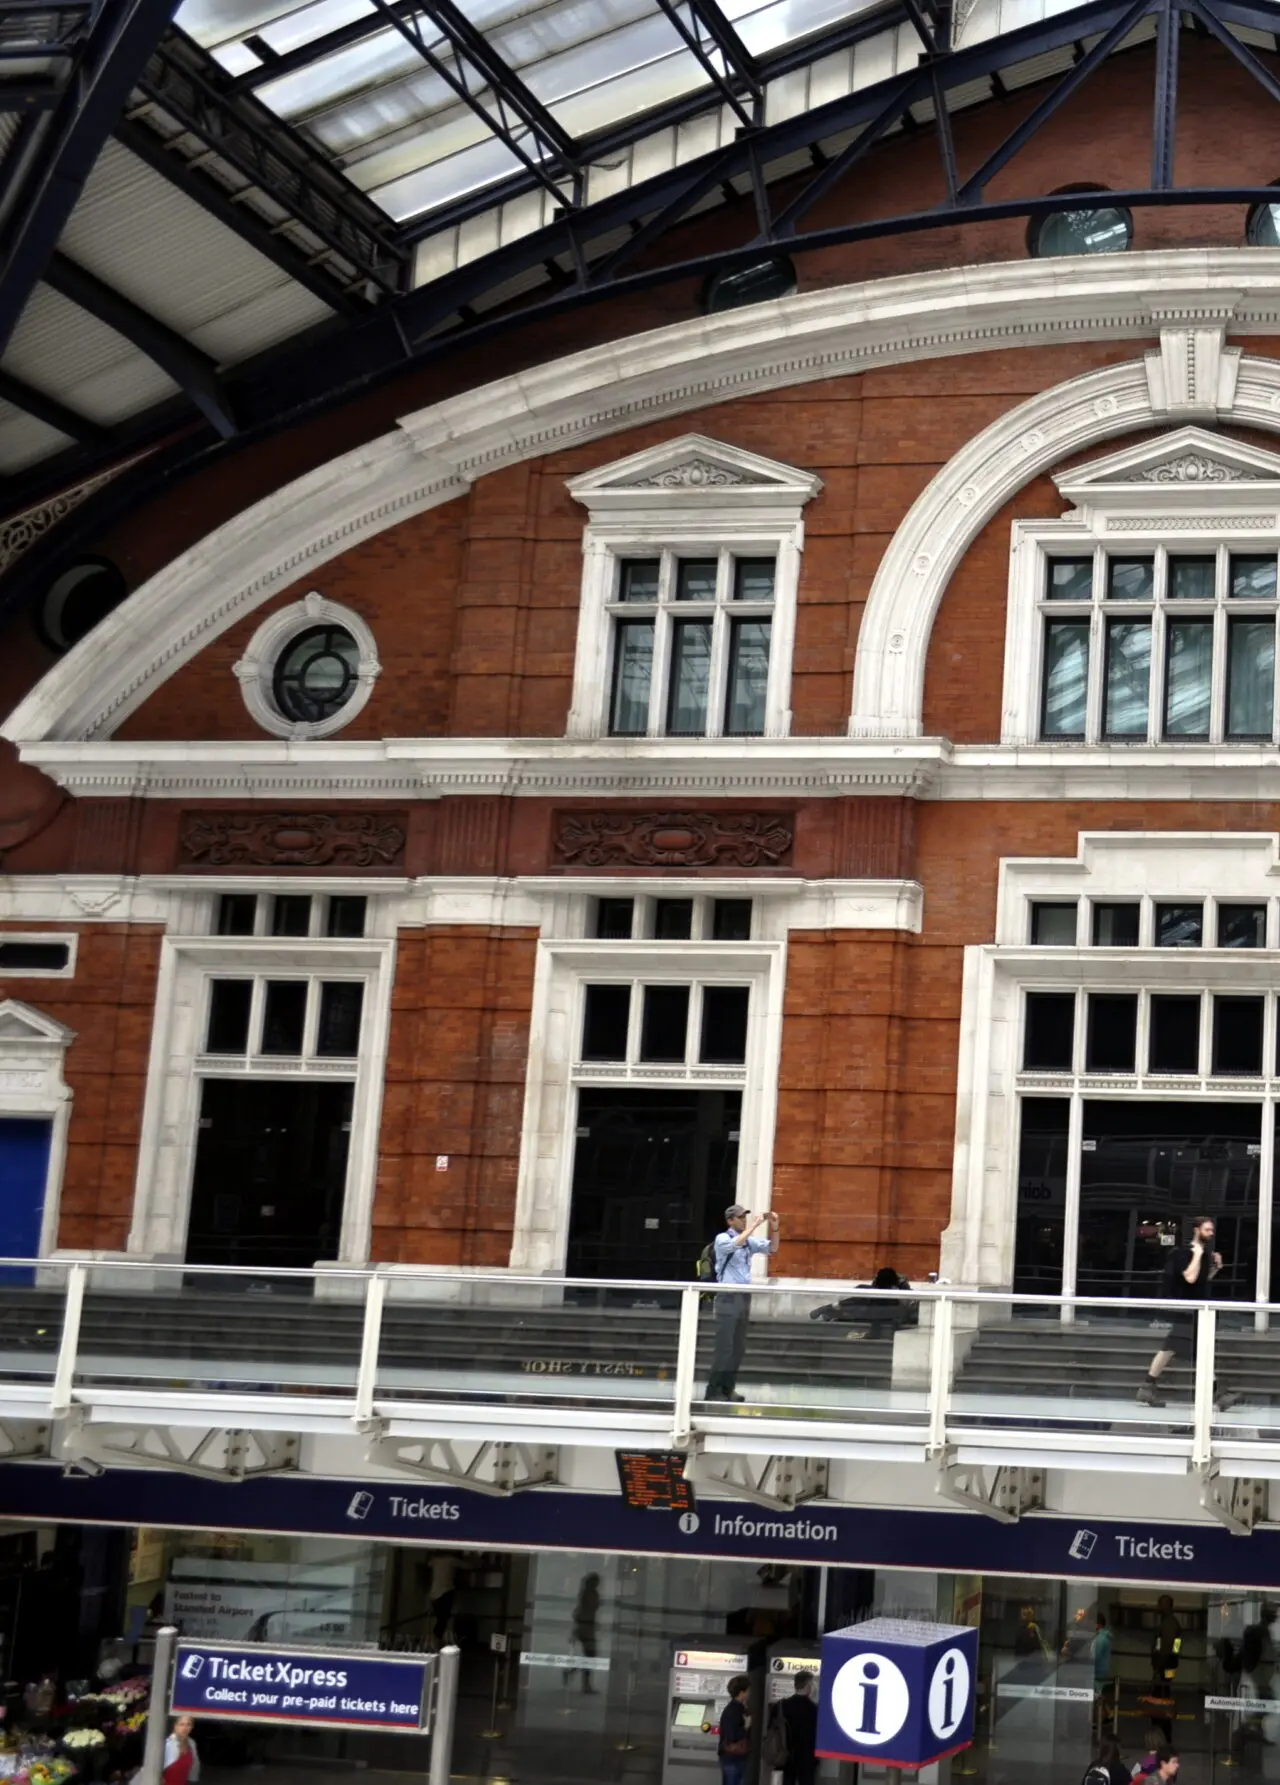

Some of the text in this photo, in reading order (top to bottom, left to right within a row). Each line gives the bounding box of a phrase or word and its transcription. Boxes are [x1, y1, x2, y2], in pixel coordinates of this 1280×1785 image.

[389, 1497, 460, 1521] Tickets
[714, 1514, 838, 1542] Information
[1115, 1536, 1194, 1561] Tickets
[211, 1592, 222, 1602] to
[218, 1605, 254, 1617] Airport
[208, 1656, 348, 1688] TicketXpress
[787, 1661, 819, 1673] Tickets
[205, 1686, 419, 1715] Collect your pre-paid tickets here
[1069, 1690, 1090, 1698] Doors
